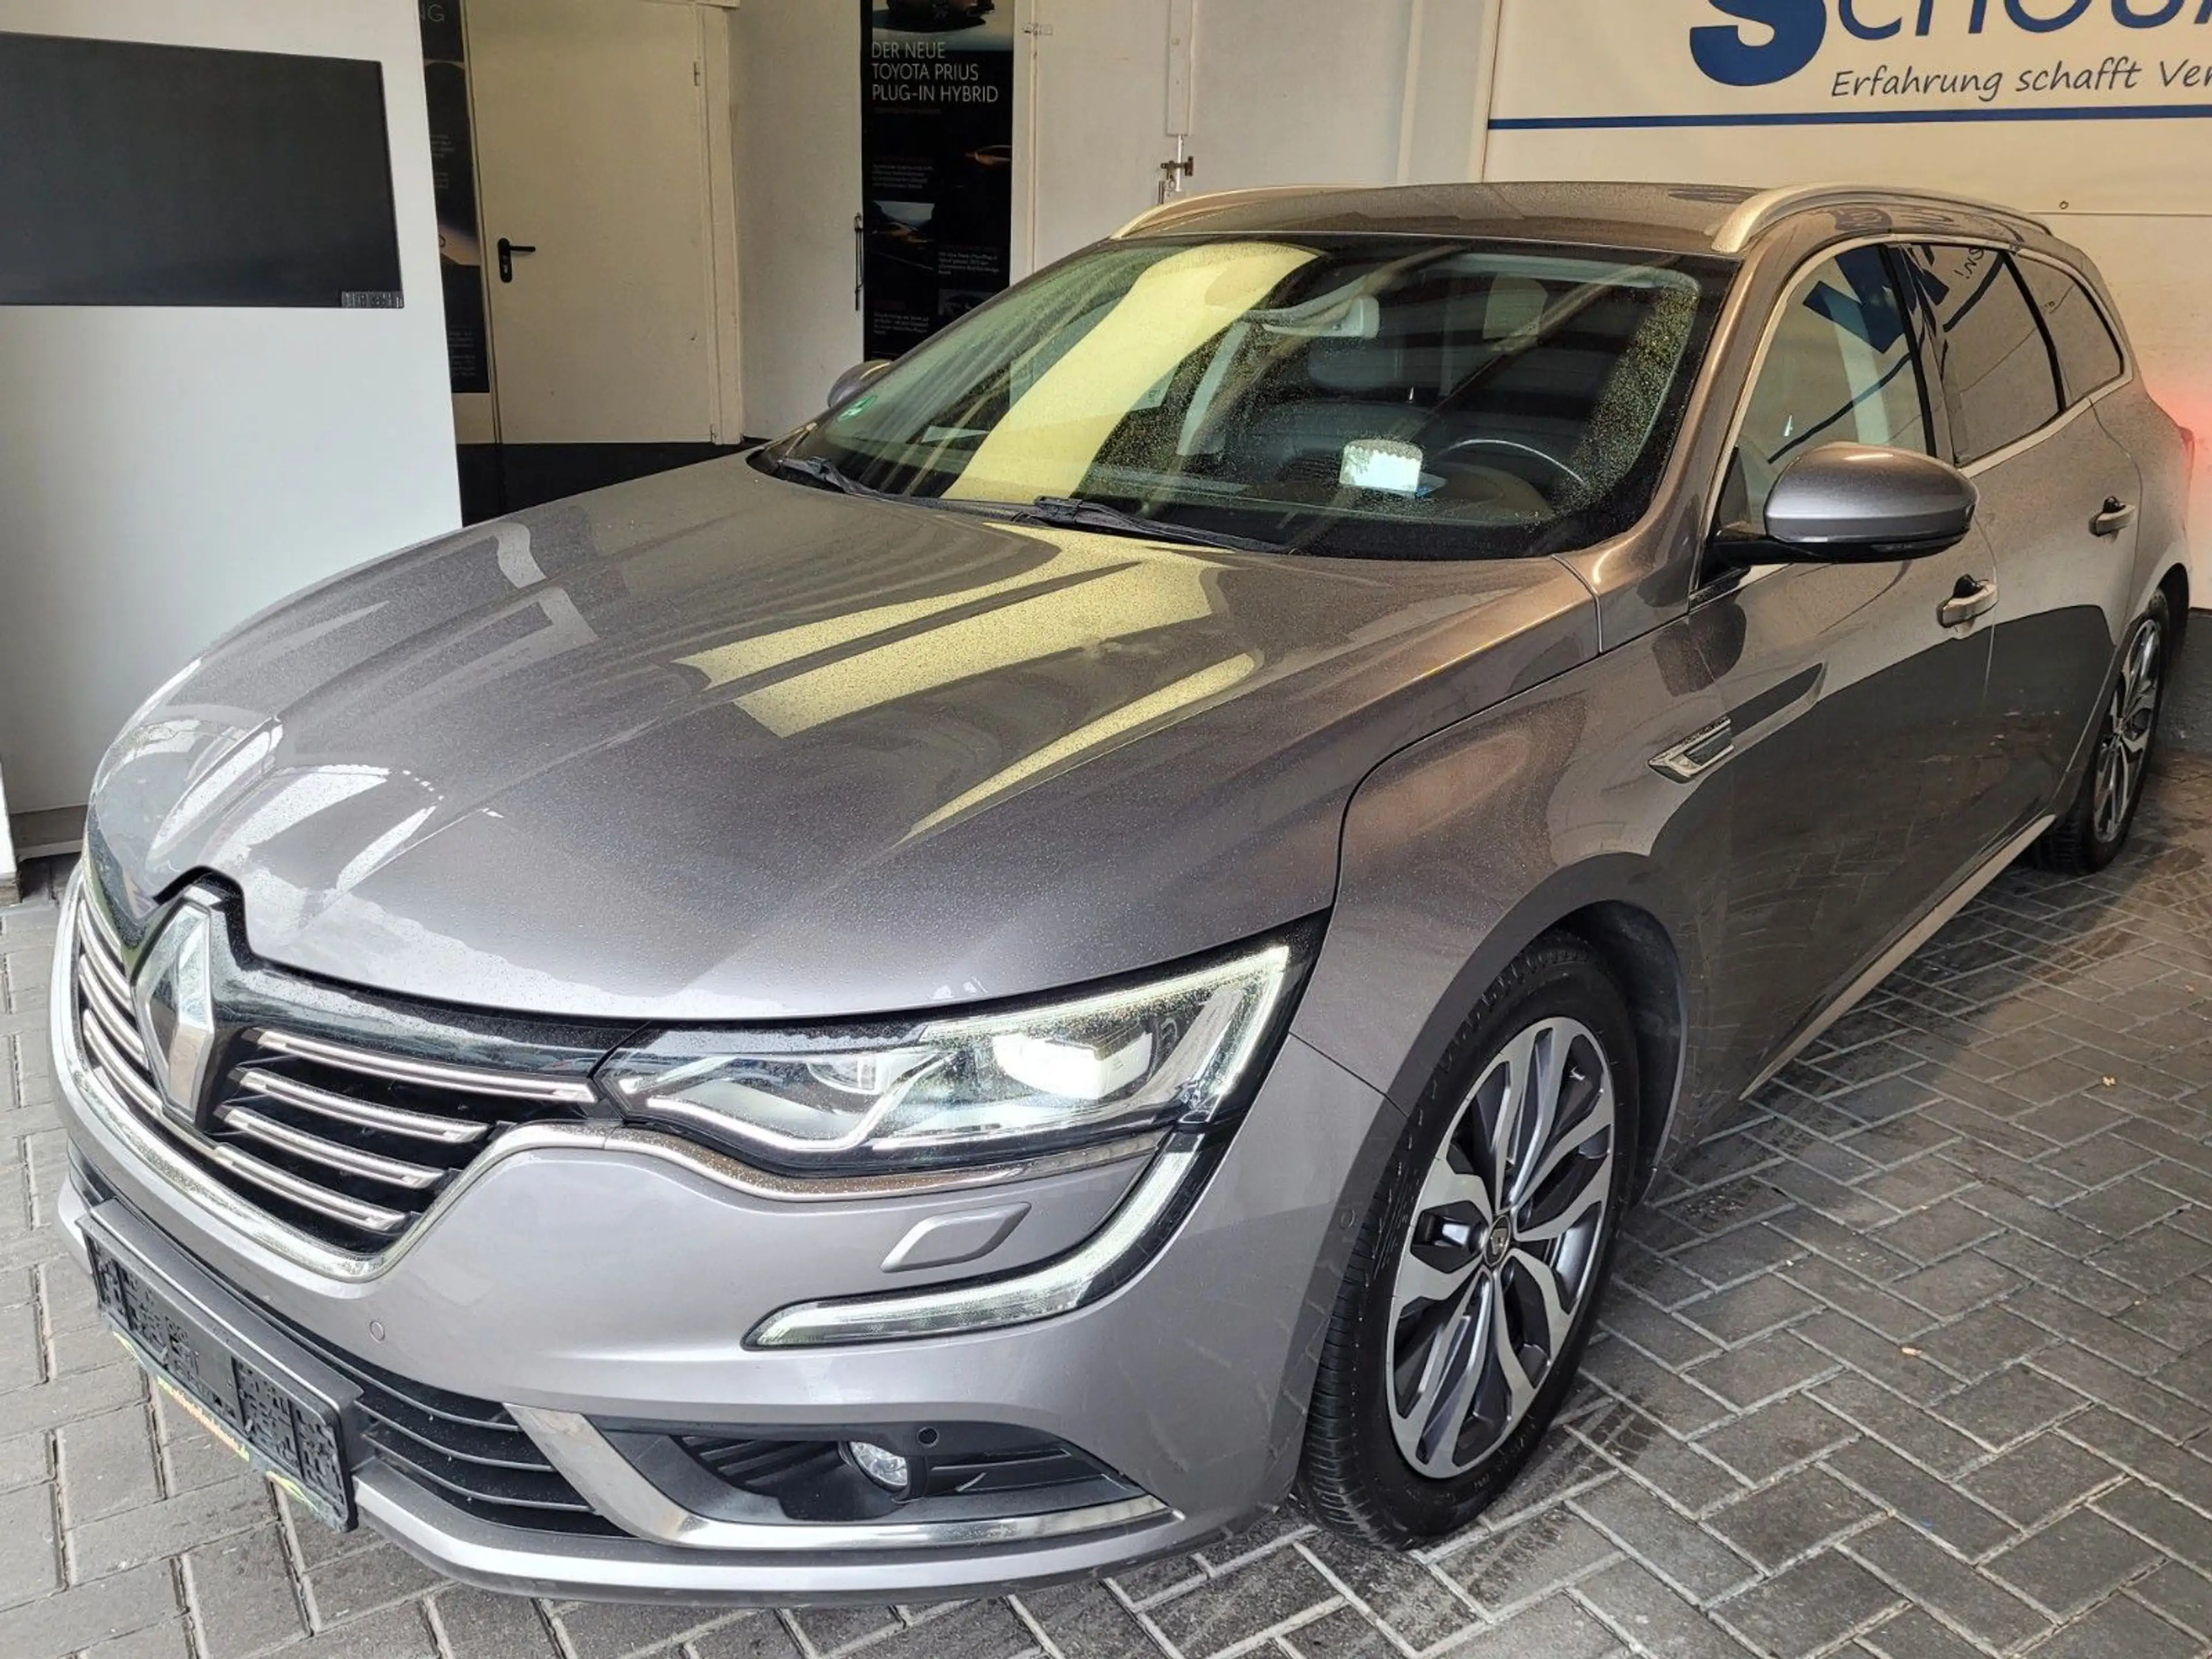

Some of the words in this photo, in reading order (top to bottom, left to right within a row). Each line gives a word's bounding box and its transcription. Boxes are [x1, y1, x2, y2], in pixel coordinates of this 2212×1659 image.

[872, 41, 900, 59] DER
[905, 41, 946, 59] NEUE
[872, 63, 930, 80] TOYOTA
[935, 63, 979, 81] PRIUS
[1831, 64, 2003, 102] Erfahrung
[2016, 56, 2142, 92] schafft
[872, 84, 934, 101] PLUG-IN
[940, 85, 999, 103] HYBRID
